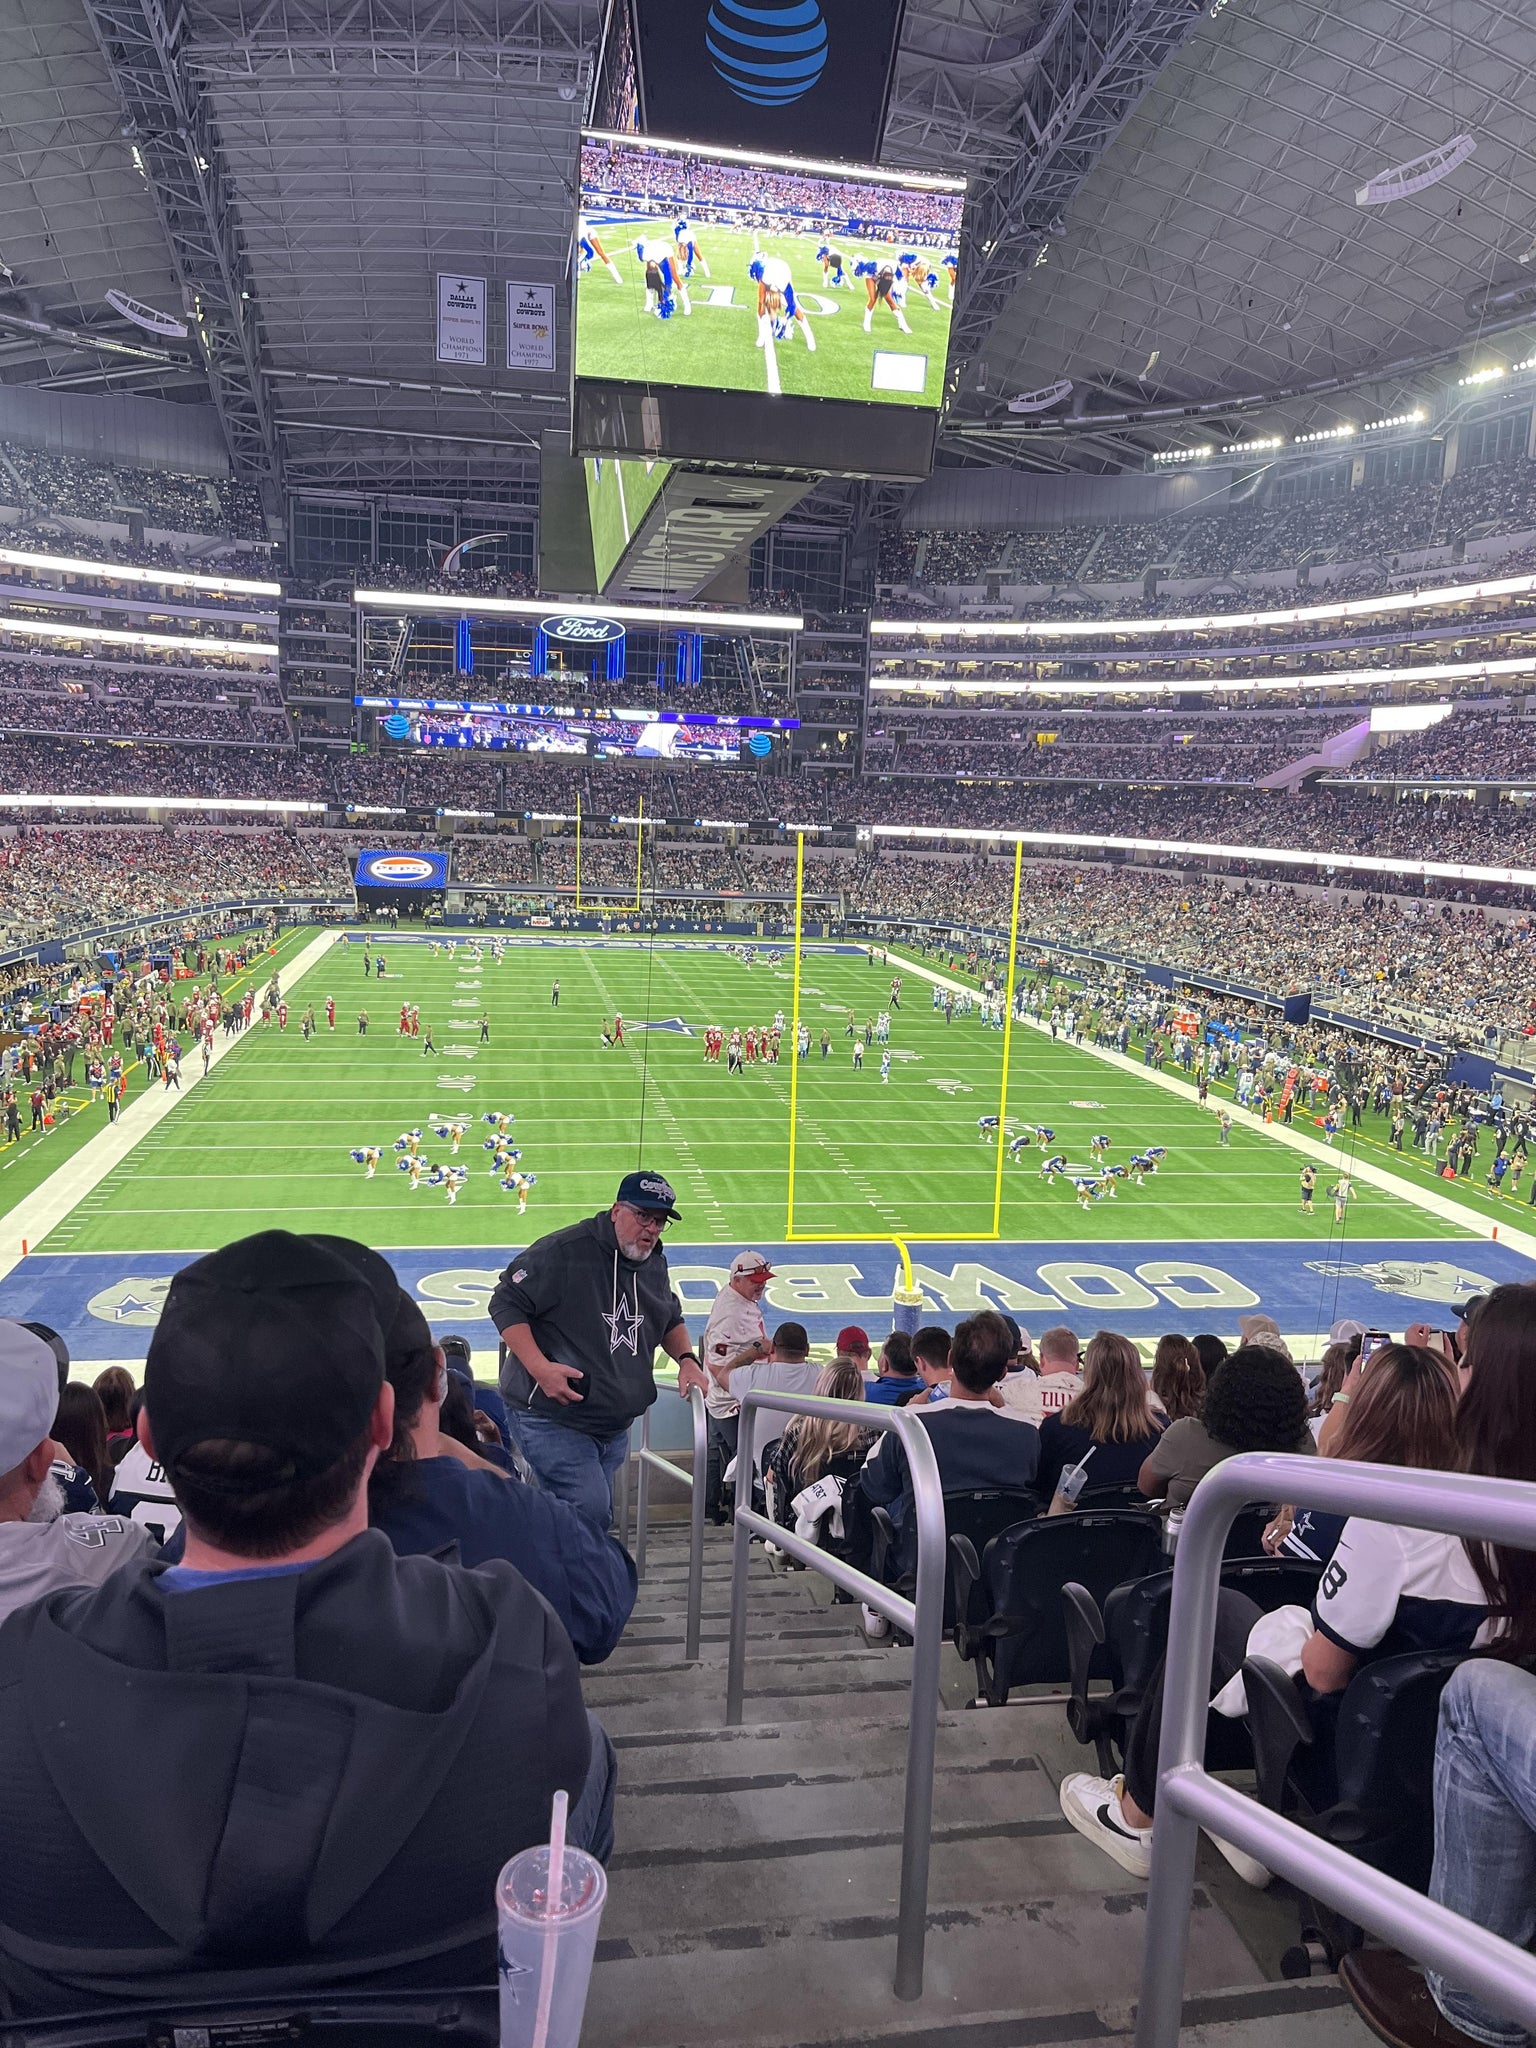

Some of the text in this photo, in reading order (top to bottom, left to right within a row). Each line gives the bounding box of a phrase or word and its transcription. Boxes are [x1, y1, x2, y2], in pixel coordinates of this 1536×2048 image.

[450, 294, 474, 302] DALLAS
[447, 301, 477, 310] COWBOYS
[516, 309, 546, 317] COWBOYS
[513, 322, 530, 330] SUPER
[449, 335, 475, 345] WORLD
[441, 343, 483, 353] CHAMPIONS
[518, 343, 544, 351] WORLD
[454, 352, 469, 360] 1971
[511, 350, 552, 360] CHAMPIONS
[620, 508, 771, 588] WINSTAR
[556, 617, 610, 639] Ford
[515, 651, 558, 660] LOS
[354, 805, 407, 814] Blockchain.com
[444, 808, 495, 818] Blockchain.com
[701, 820, 749, 828] Blockchain.com
[785, 823, 833, 831] Blockchain.com
[376, 865, 428, 873] PEPSI
[811, 1483, 827, 1500] AT&T
[62, 1517, 125, 1550] 4
[1322, 1559, 1348, 1600] 8
